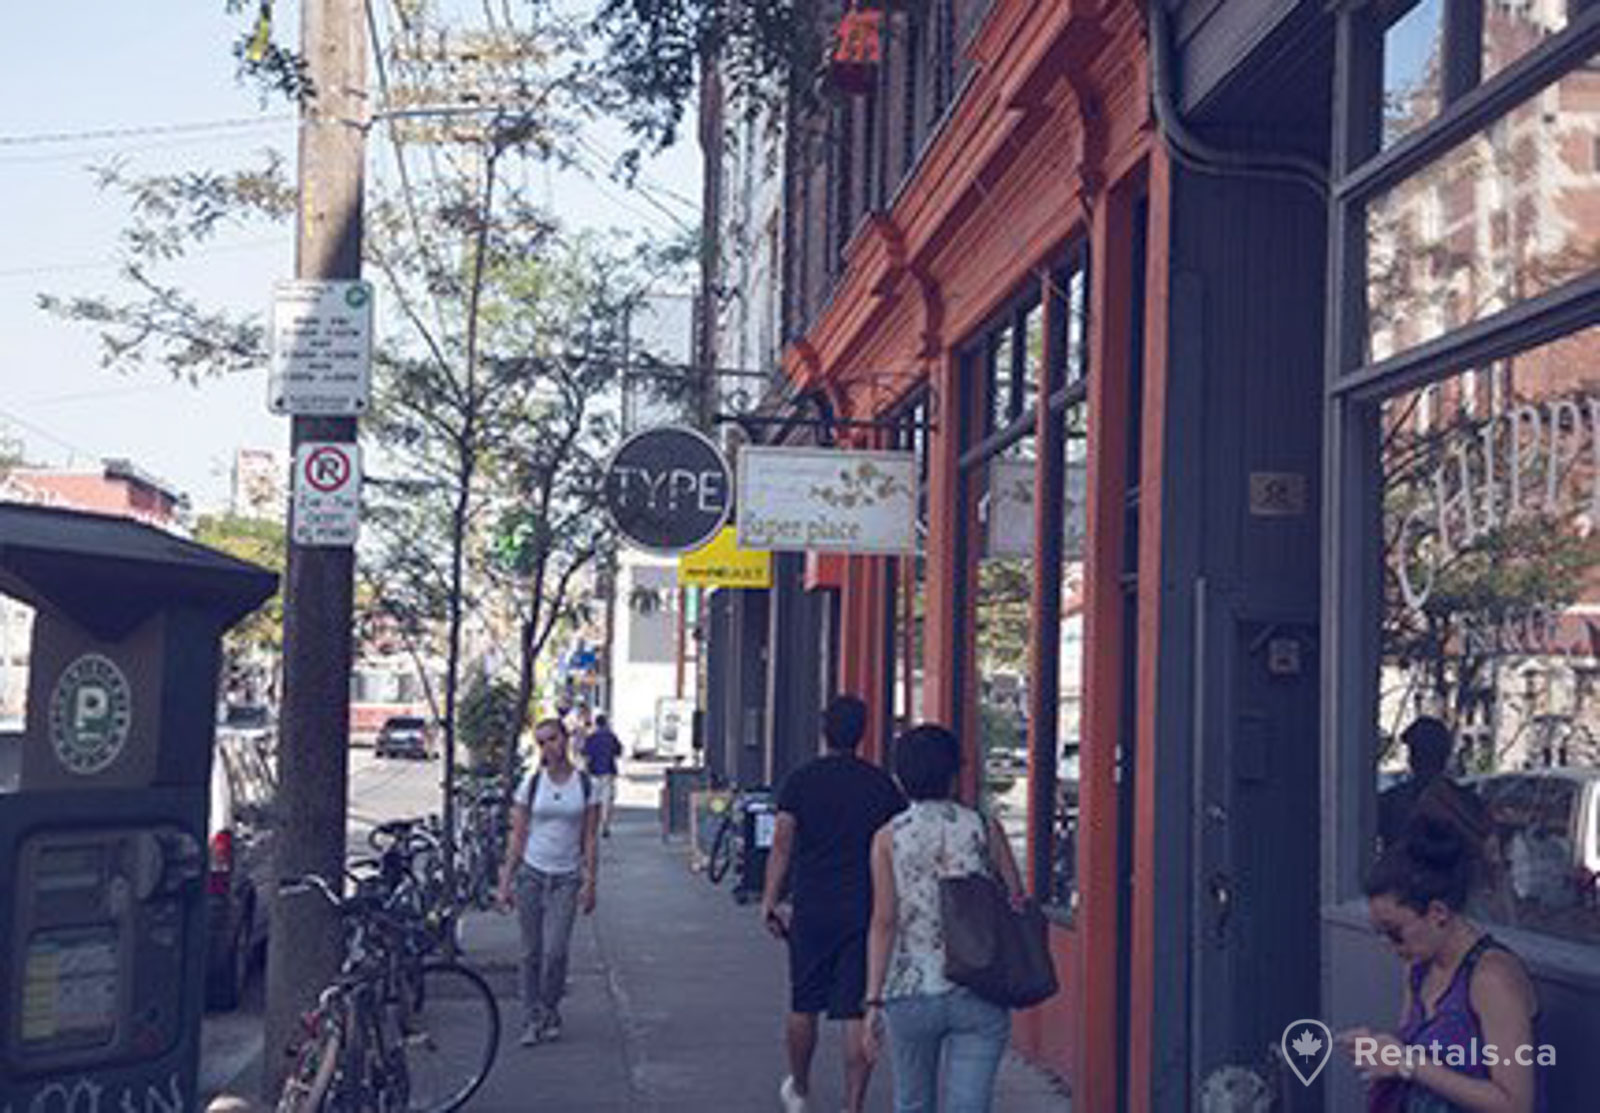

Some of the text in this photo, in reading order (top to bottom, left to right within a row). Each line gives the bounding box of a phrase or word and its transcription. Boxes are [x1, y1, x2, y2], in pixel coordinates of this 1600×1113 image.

[613, 466, 723, 512] TYPE
[1399, 397, 1600, 609] CHIPP
[76, 686, 108, 728] P
